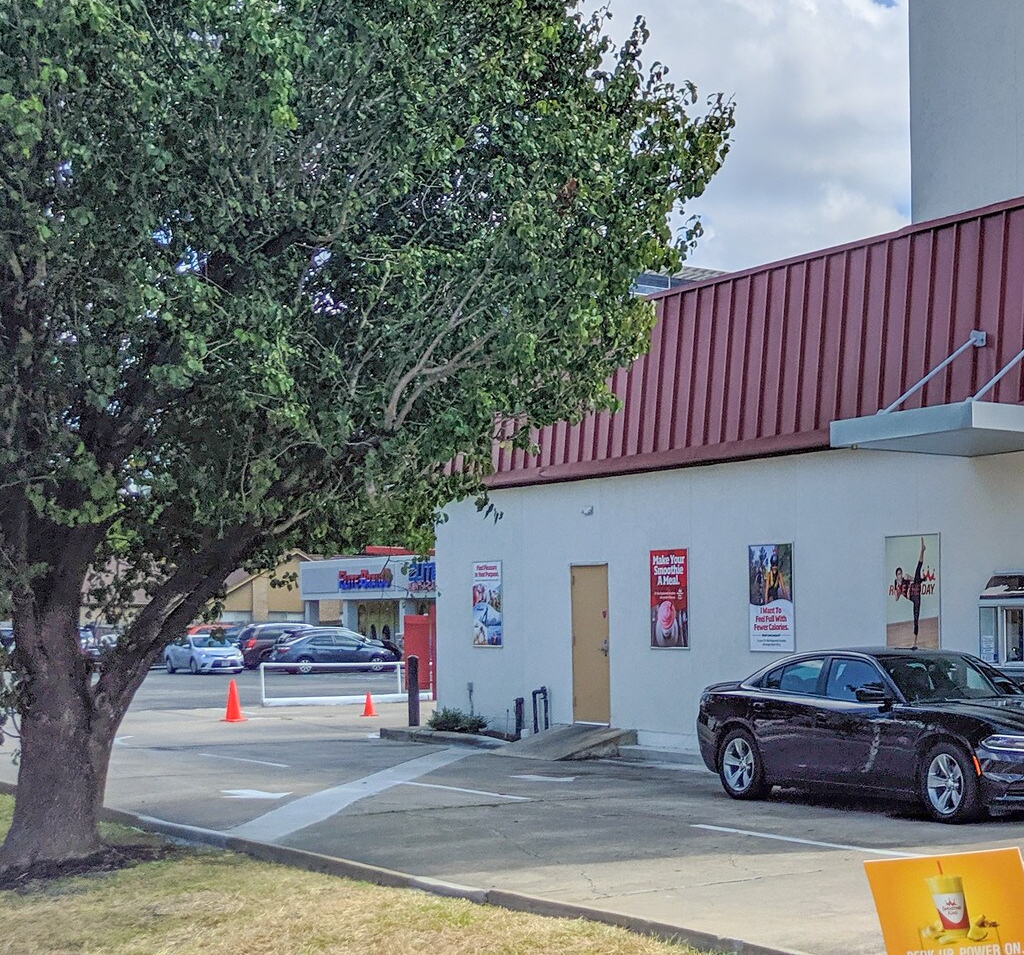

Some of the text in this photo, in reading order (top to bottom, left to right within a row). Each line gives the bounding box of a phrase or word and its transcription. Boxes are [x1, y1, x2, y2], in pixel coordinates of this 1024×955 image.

[652, 554, 685, 565] Make Your
[653, 564, 684, 575] Smoothie
[657, 575, 663, 585] A
[921, 584, 935, 595] DAY
[775, 606, 782, 614] To
[753, 623, 768, 631] Fewer
[960, 944, 1001, 955] POWER
[1004, 942, 1024, 955] ON.
